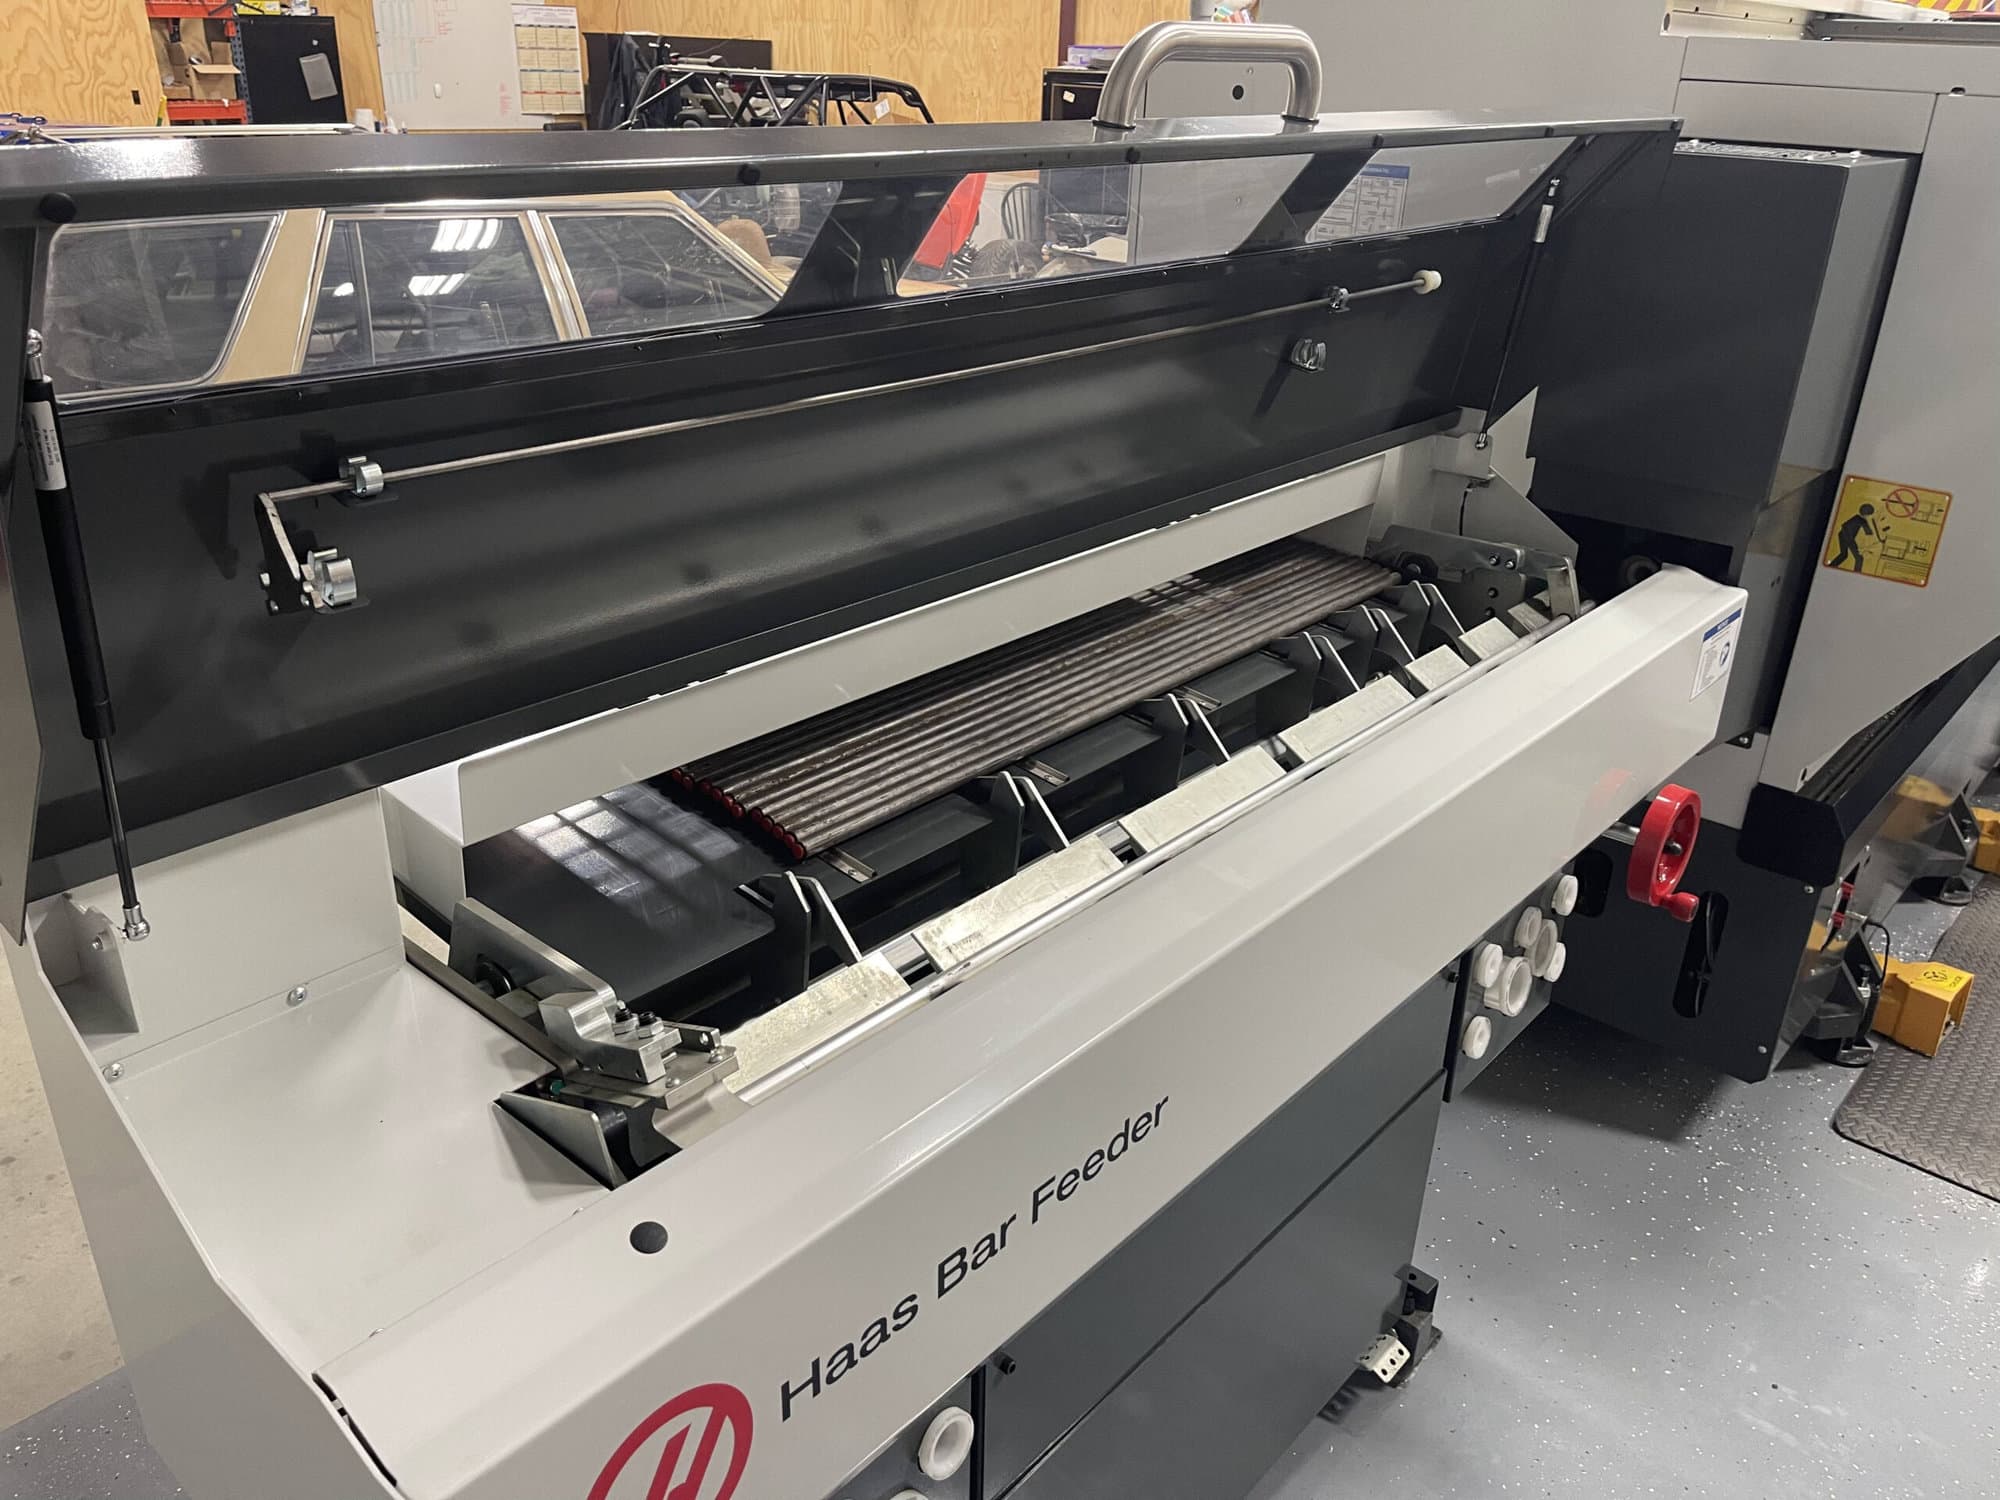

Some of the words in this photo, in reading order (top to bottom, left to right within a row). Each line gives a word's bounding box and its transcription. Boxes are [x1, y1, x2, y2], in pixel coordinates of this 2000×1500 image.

[781, 1294, 919, 1422] Haas
[937, 1213, 1018, 1299] Bar
[1032, 1095, 1169, 1225] Feeder
